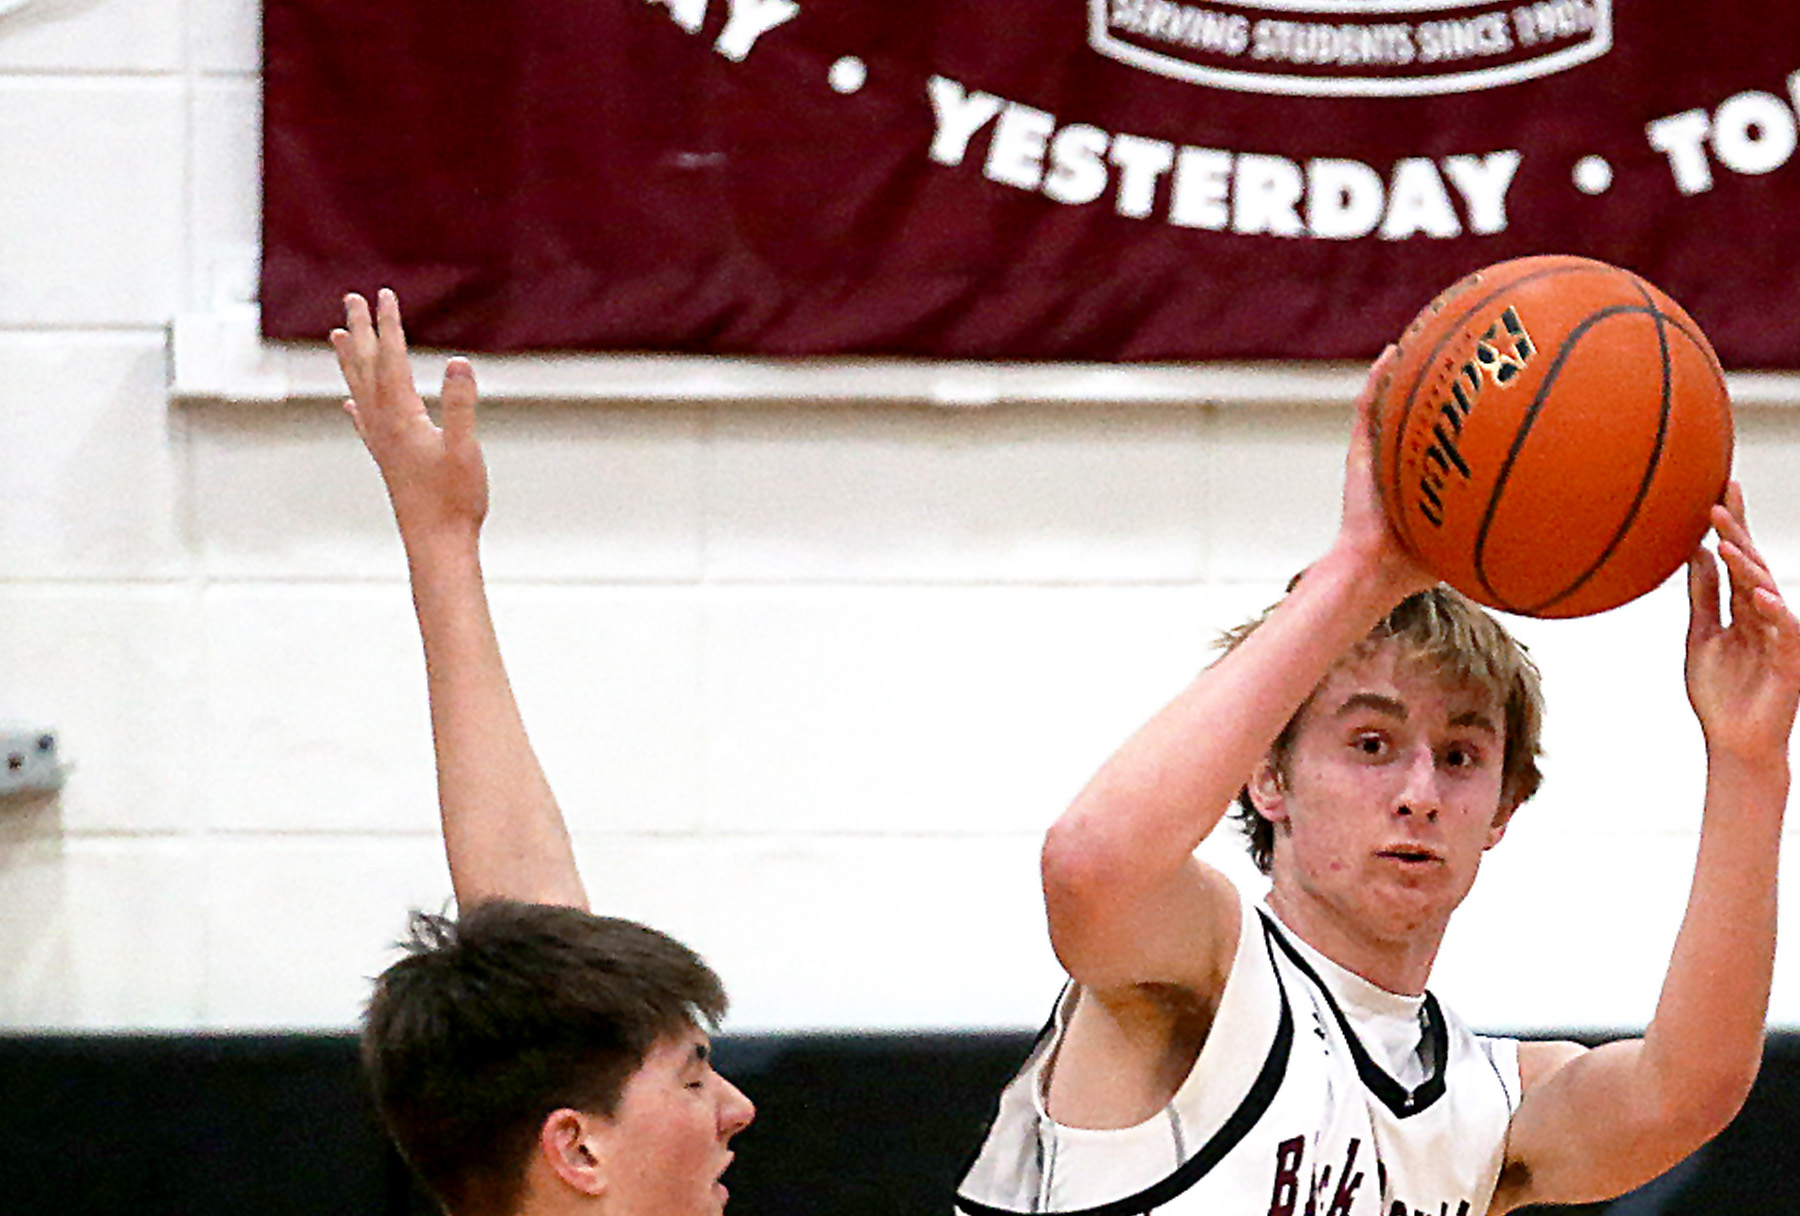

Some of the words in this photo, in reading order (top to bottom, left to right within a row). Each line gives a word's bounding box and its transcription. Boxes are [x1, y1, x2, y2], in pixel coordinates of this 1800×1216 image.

[1251, 18, 1414, 66] STUDENTS
[1414, 11, 1515, 63] SINCE
[926, 74, 1521, 241] YESTERDAY
